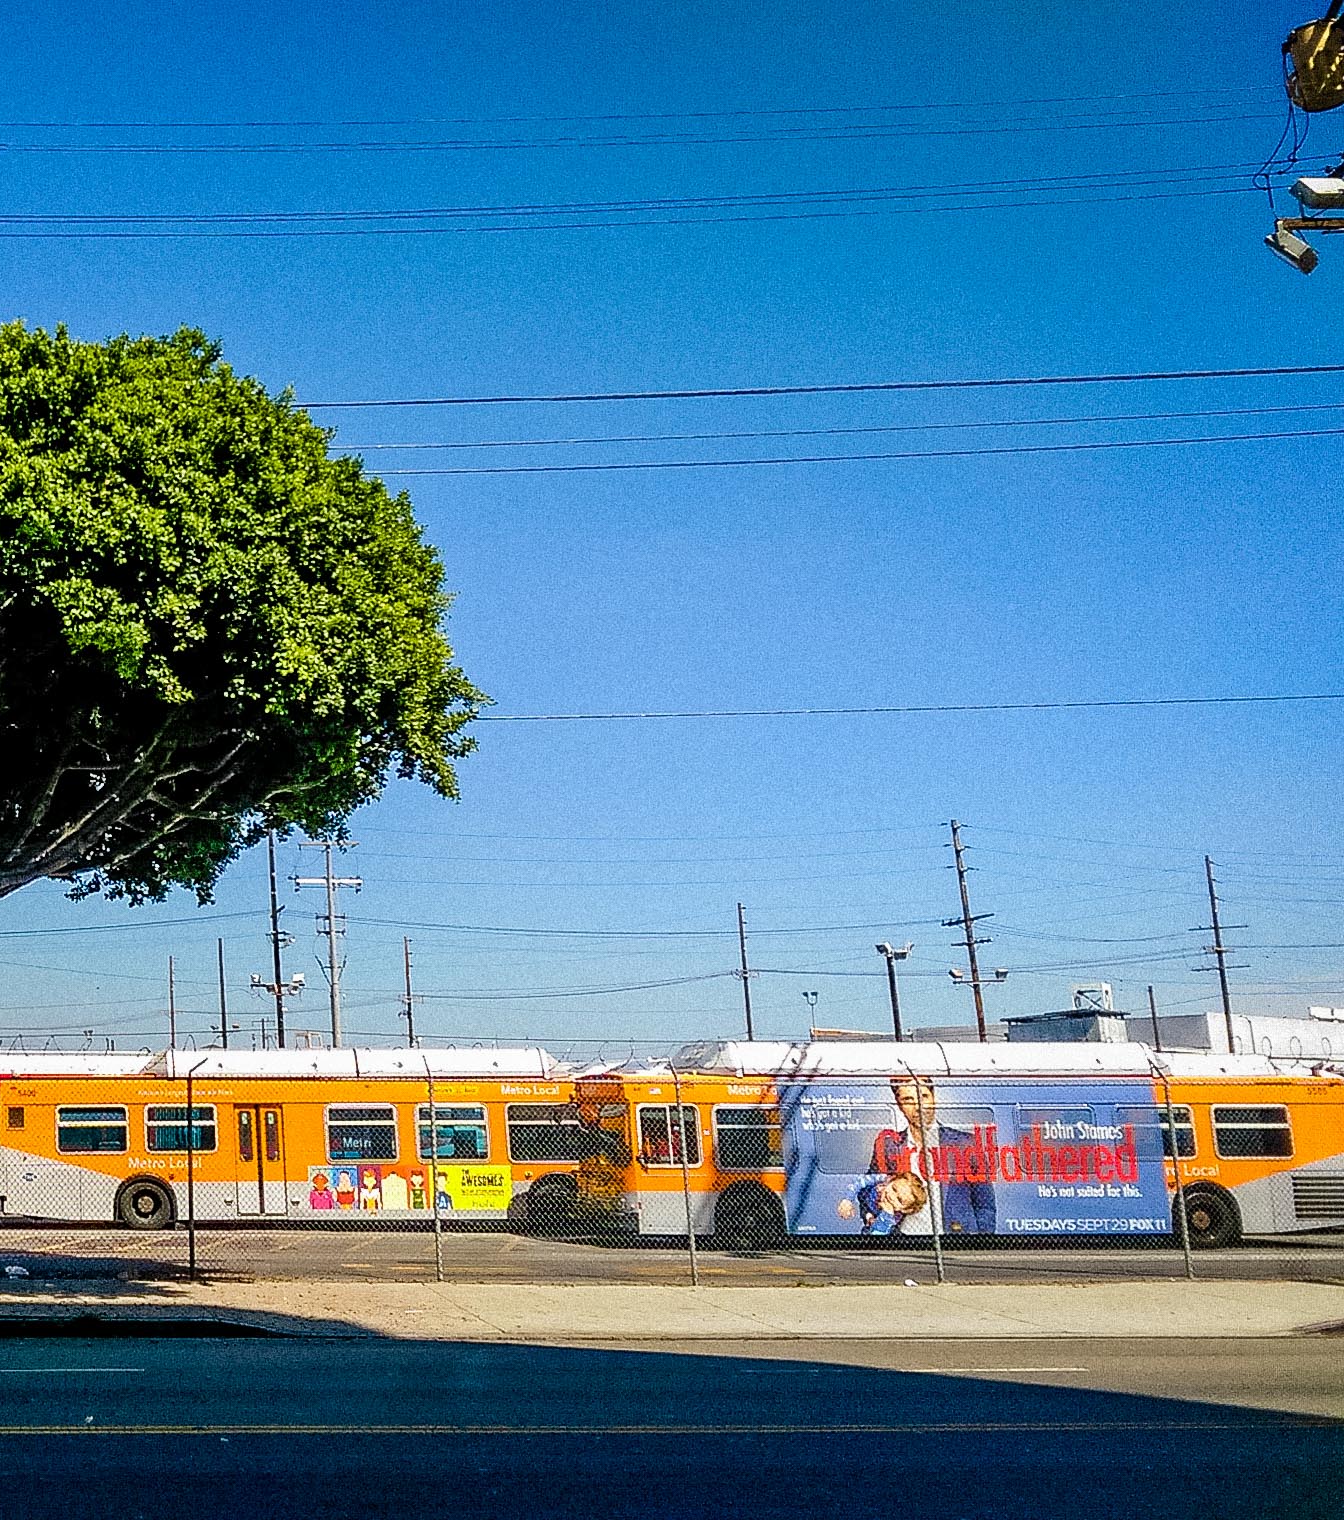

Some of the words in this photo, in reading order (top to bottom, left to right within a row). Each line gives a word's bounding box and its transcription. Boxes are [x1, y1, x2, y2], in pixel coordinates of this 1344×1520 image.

[501, 1085, 530, 1095] Metro
[533, 1085, 560, 1095] Local
[727, 1085, 762, 1095] Metro
[1044, 1120, 1074, 1140] John
[1077, 1121, 1124, 1139] Stamos
[873, 1121, 1140, 1184] Grandfathered
[128, 1157, 165, 1169] Metro
[1183, 1164, 1219, 1177] Local
[461, 1174, 505, 1187] AWESOMES
[1038, 1185, 1058, 1197] He's
[1059, 1186, 1075, 1197] not
[1076, 1185, 1105, 1197] suited
[1106, 1184, 1121, 1197] for
[1123, 1184, 1143, 1197] this.
[1006, 1219, 1076, 1231] TUESDAYS
[1077, 1219, 1108, 1231] SEPT
[1111, 1219, 1128, 1231] 29
[1129, 1219, 1154, 1231] FOX
[1155, 1219, 1166, 1231] 11
